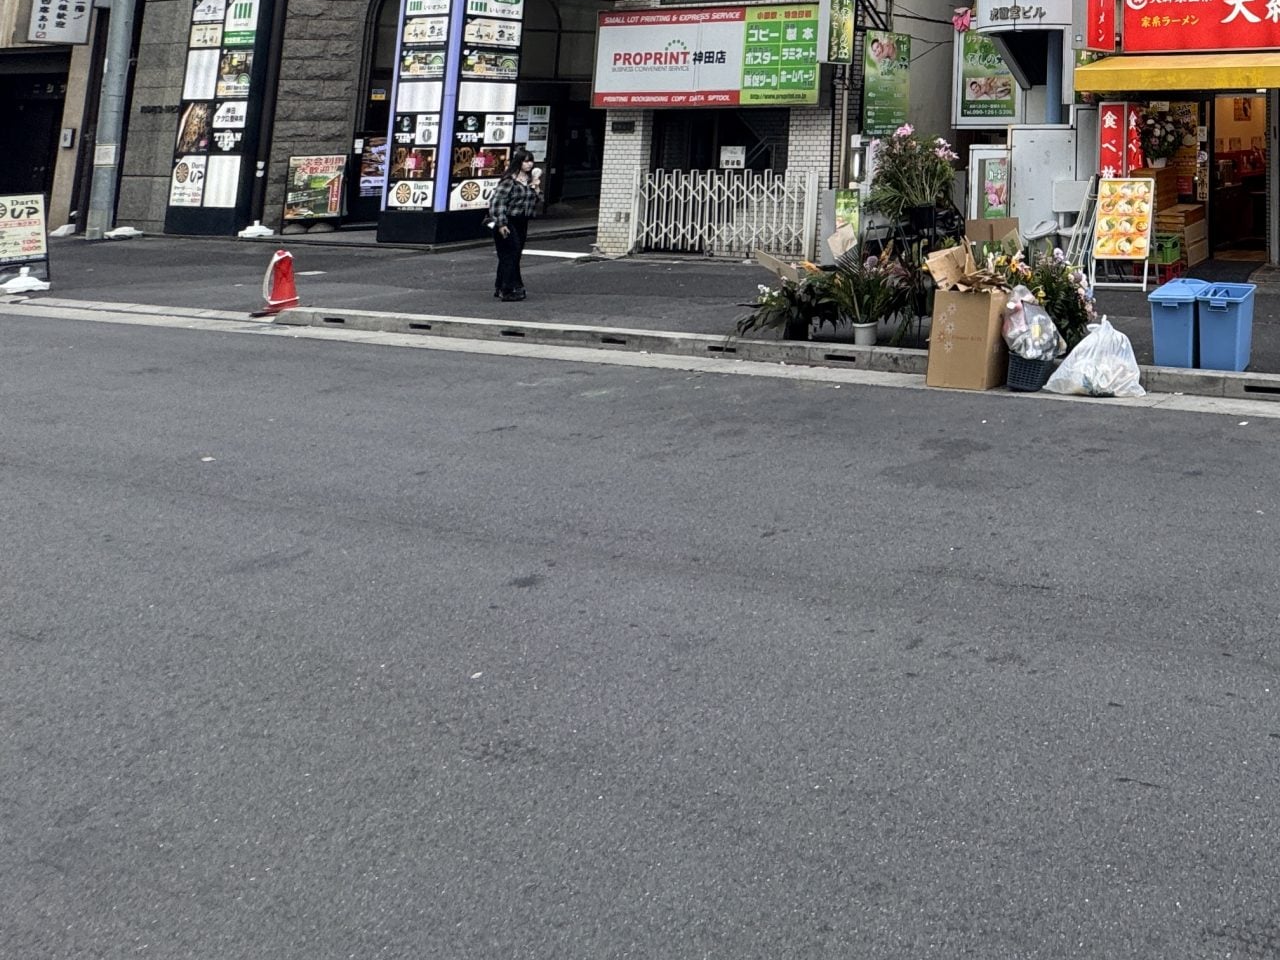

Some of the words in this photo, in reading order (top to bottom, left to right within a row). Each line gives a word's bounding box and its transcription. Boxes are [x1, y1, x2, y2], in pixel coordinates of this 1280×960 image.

[604, 16, 625, 24] SMALL
[627, 15, 640, 23] LOT
[640, 15, 671, 23] PRINTING
[679, 13, 710, 21] EXPRESS
[711, 11, 741, 20] SERVICE
[1140, 14, 1200, 28] 家系ラーメン
[748, 28, 779, 41] コピー
[613, 50, 690, 66] PROPRINT
[692, 50, 727, 65] 神田店
[745, 51, 779, 65] ポスター
[781, 47, 816, 61] ラミネート
[780, 69, 815, 83] ホームページ
[11, 199, 39, 207] Darts
[412, 192, 428, 205] UP
[11, 207, 39, 219] UP
